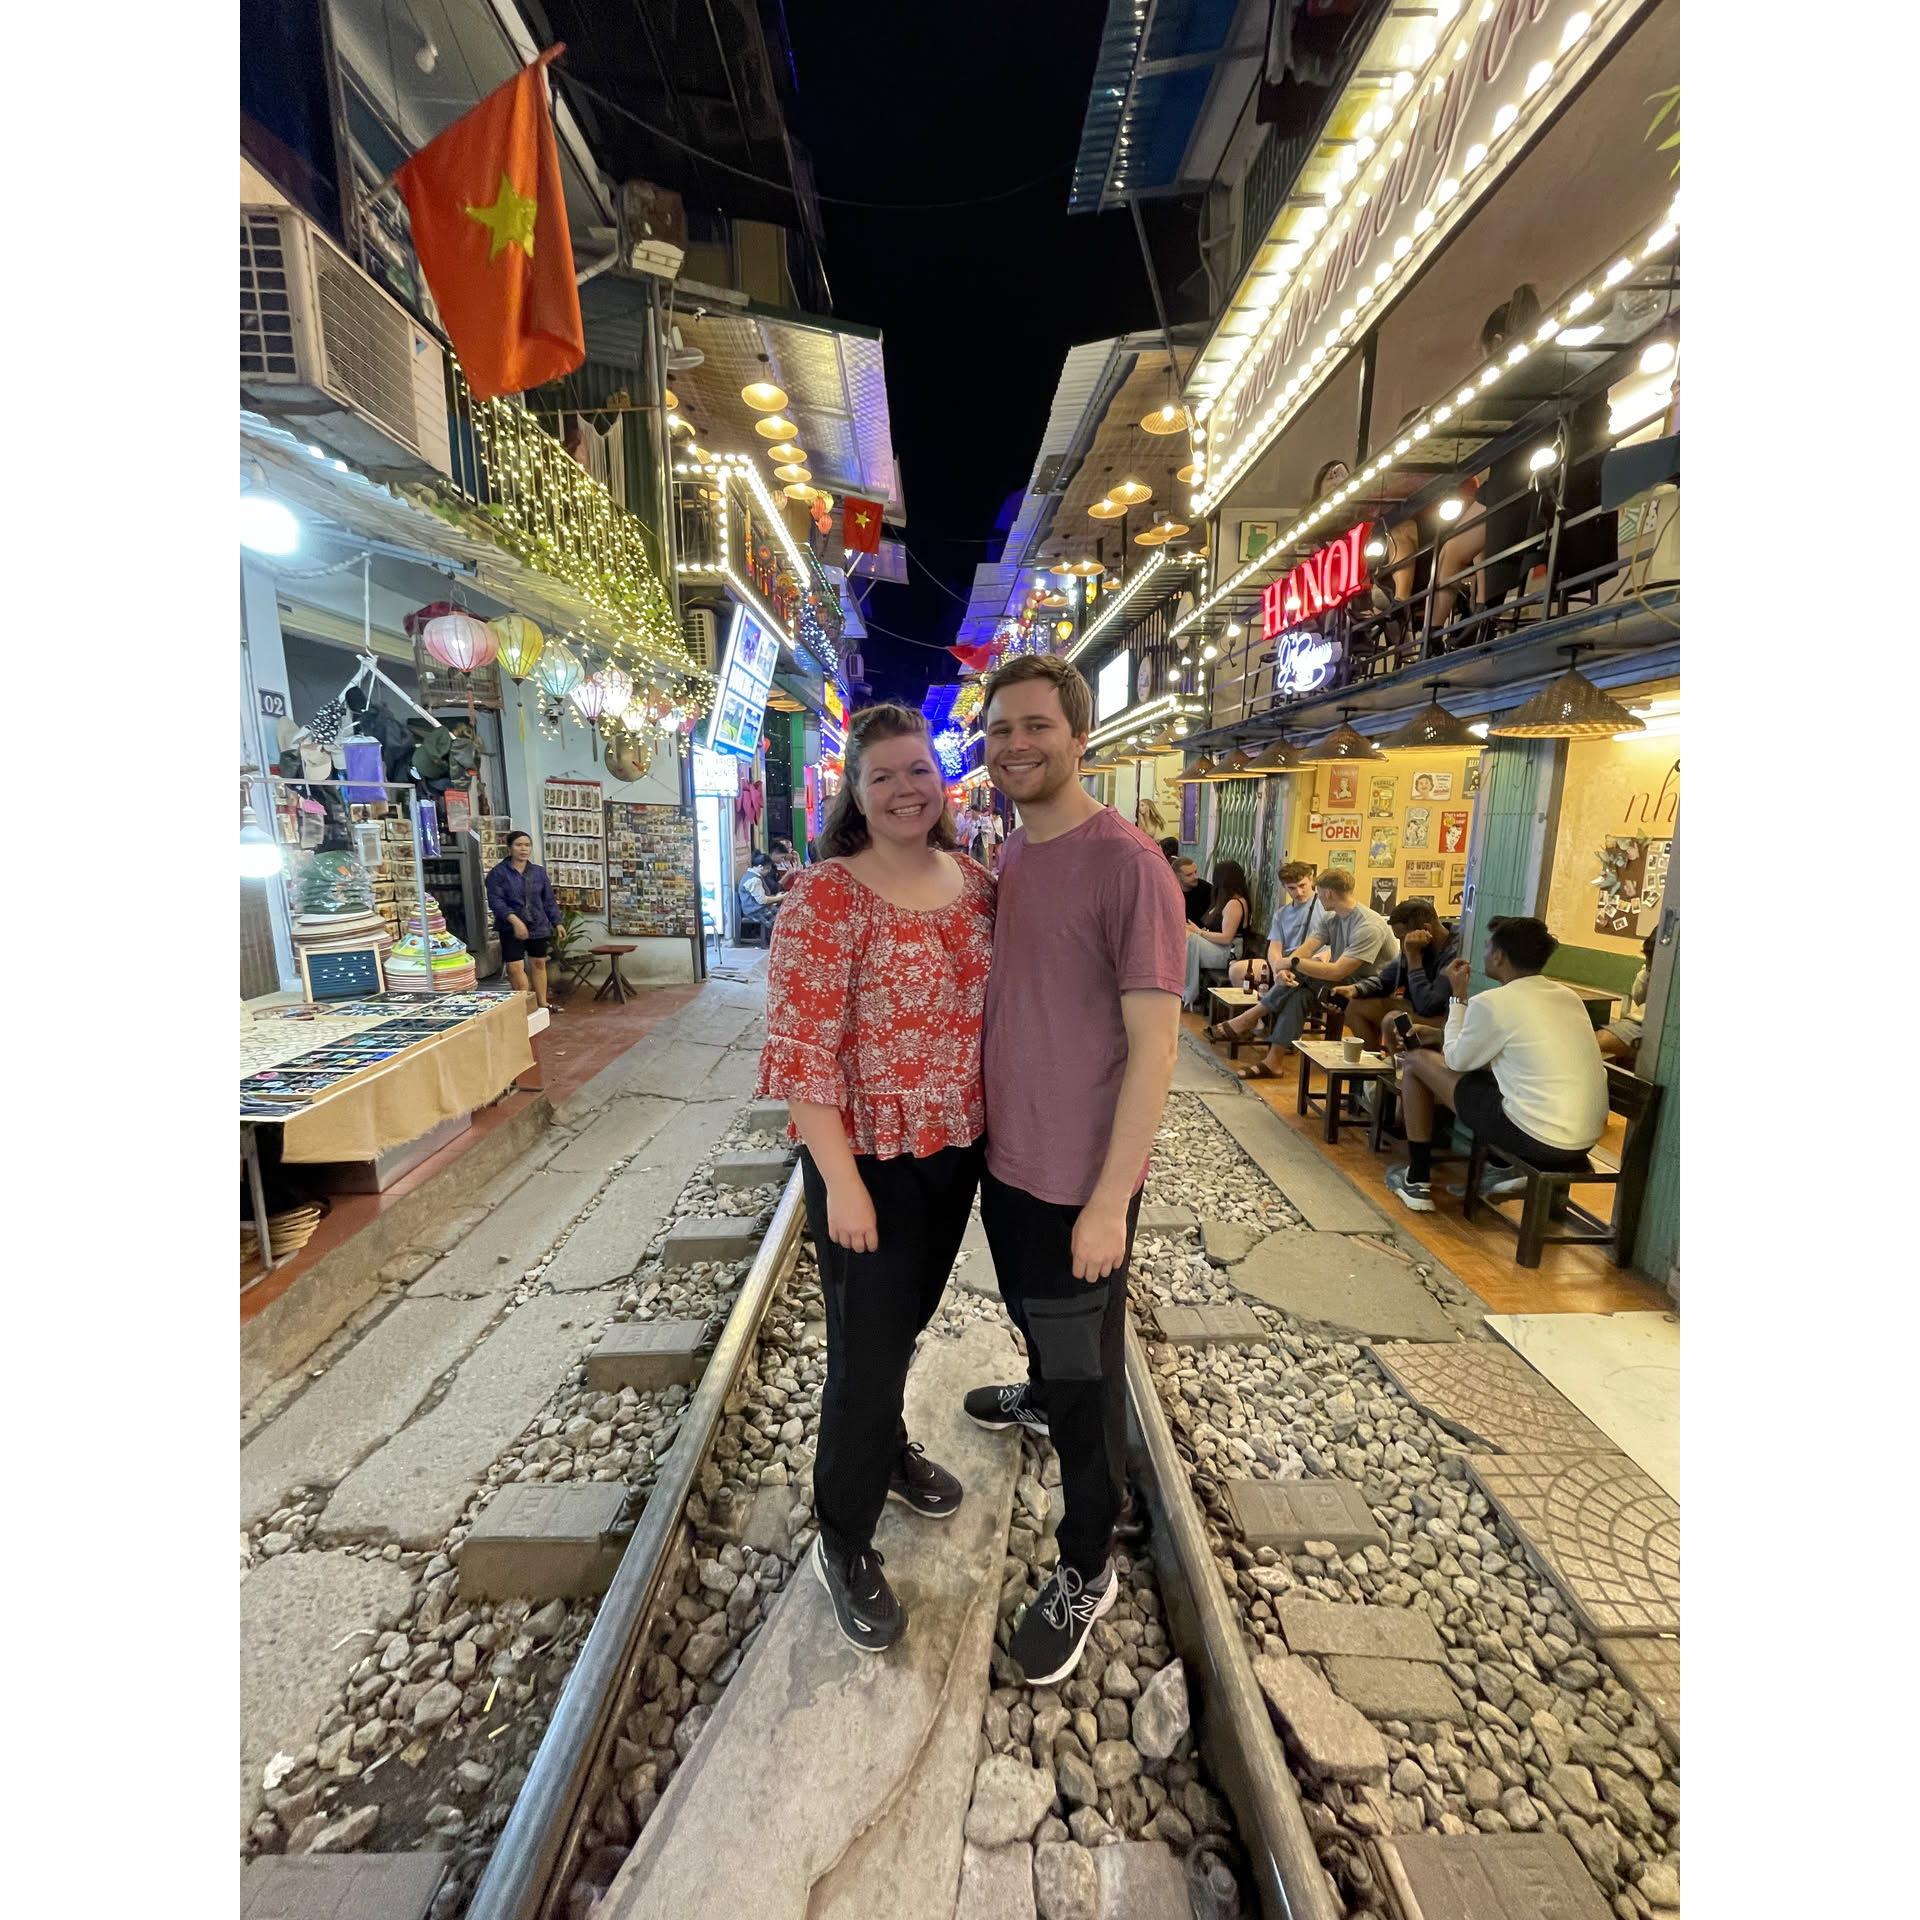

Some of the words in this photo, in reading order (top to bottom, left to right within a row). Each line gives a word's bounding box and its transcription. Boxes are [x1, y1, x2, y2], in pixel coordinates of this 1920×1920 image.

[1423, 0, 1551, 207] yo
[1262, 521, 1366, 640] HANOI
[261, 694, 284, 716] 02
[1325, 826, 1360, 839] OPEN
